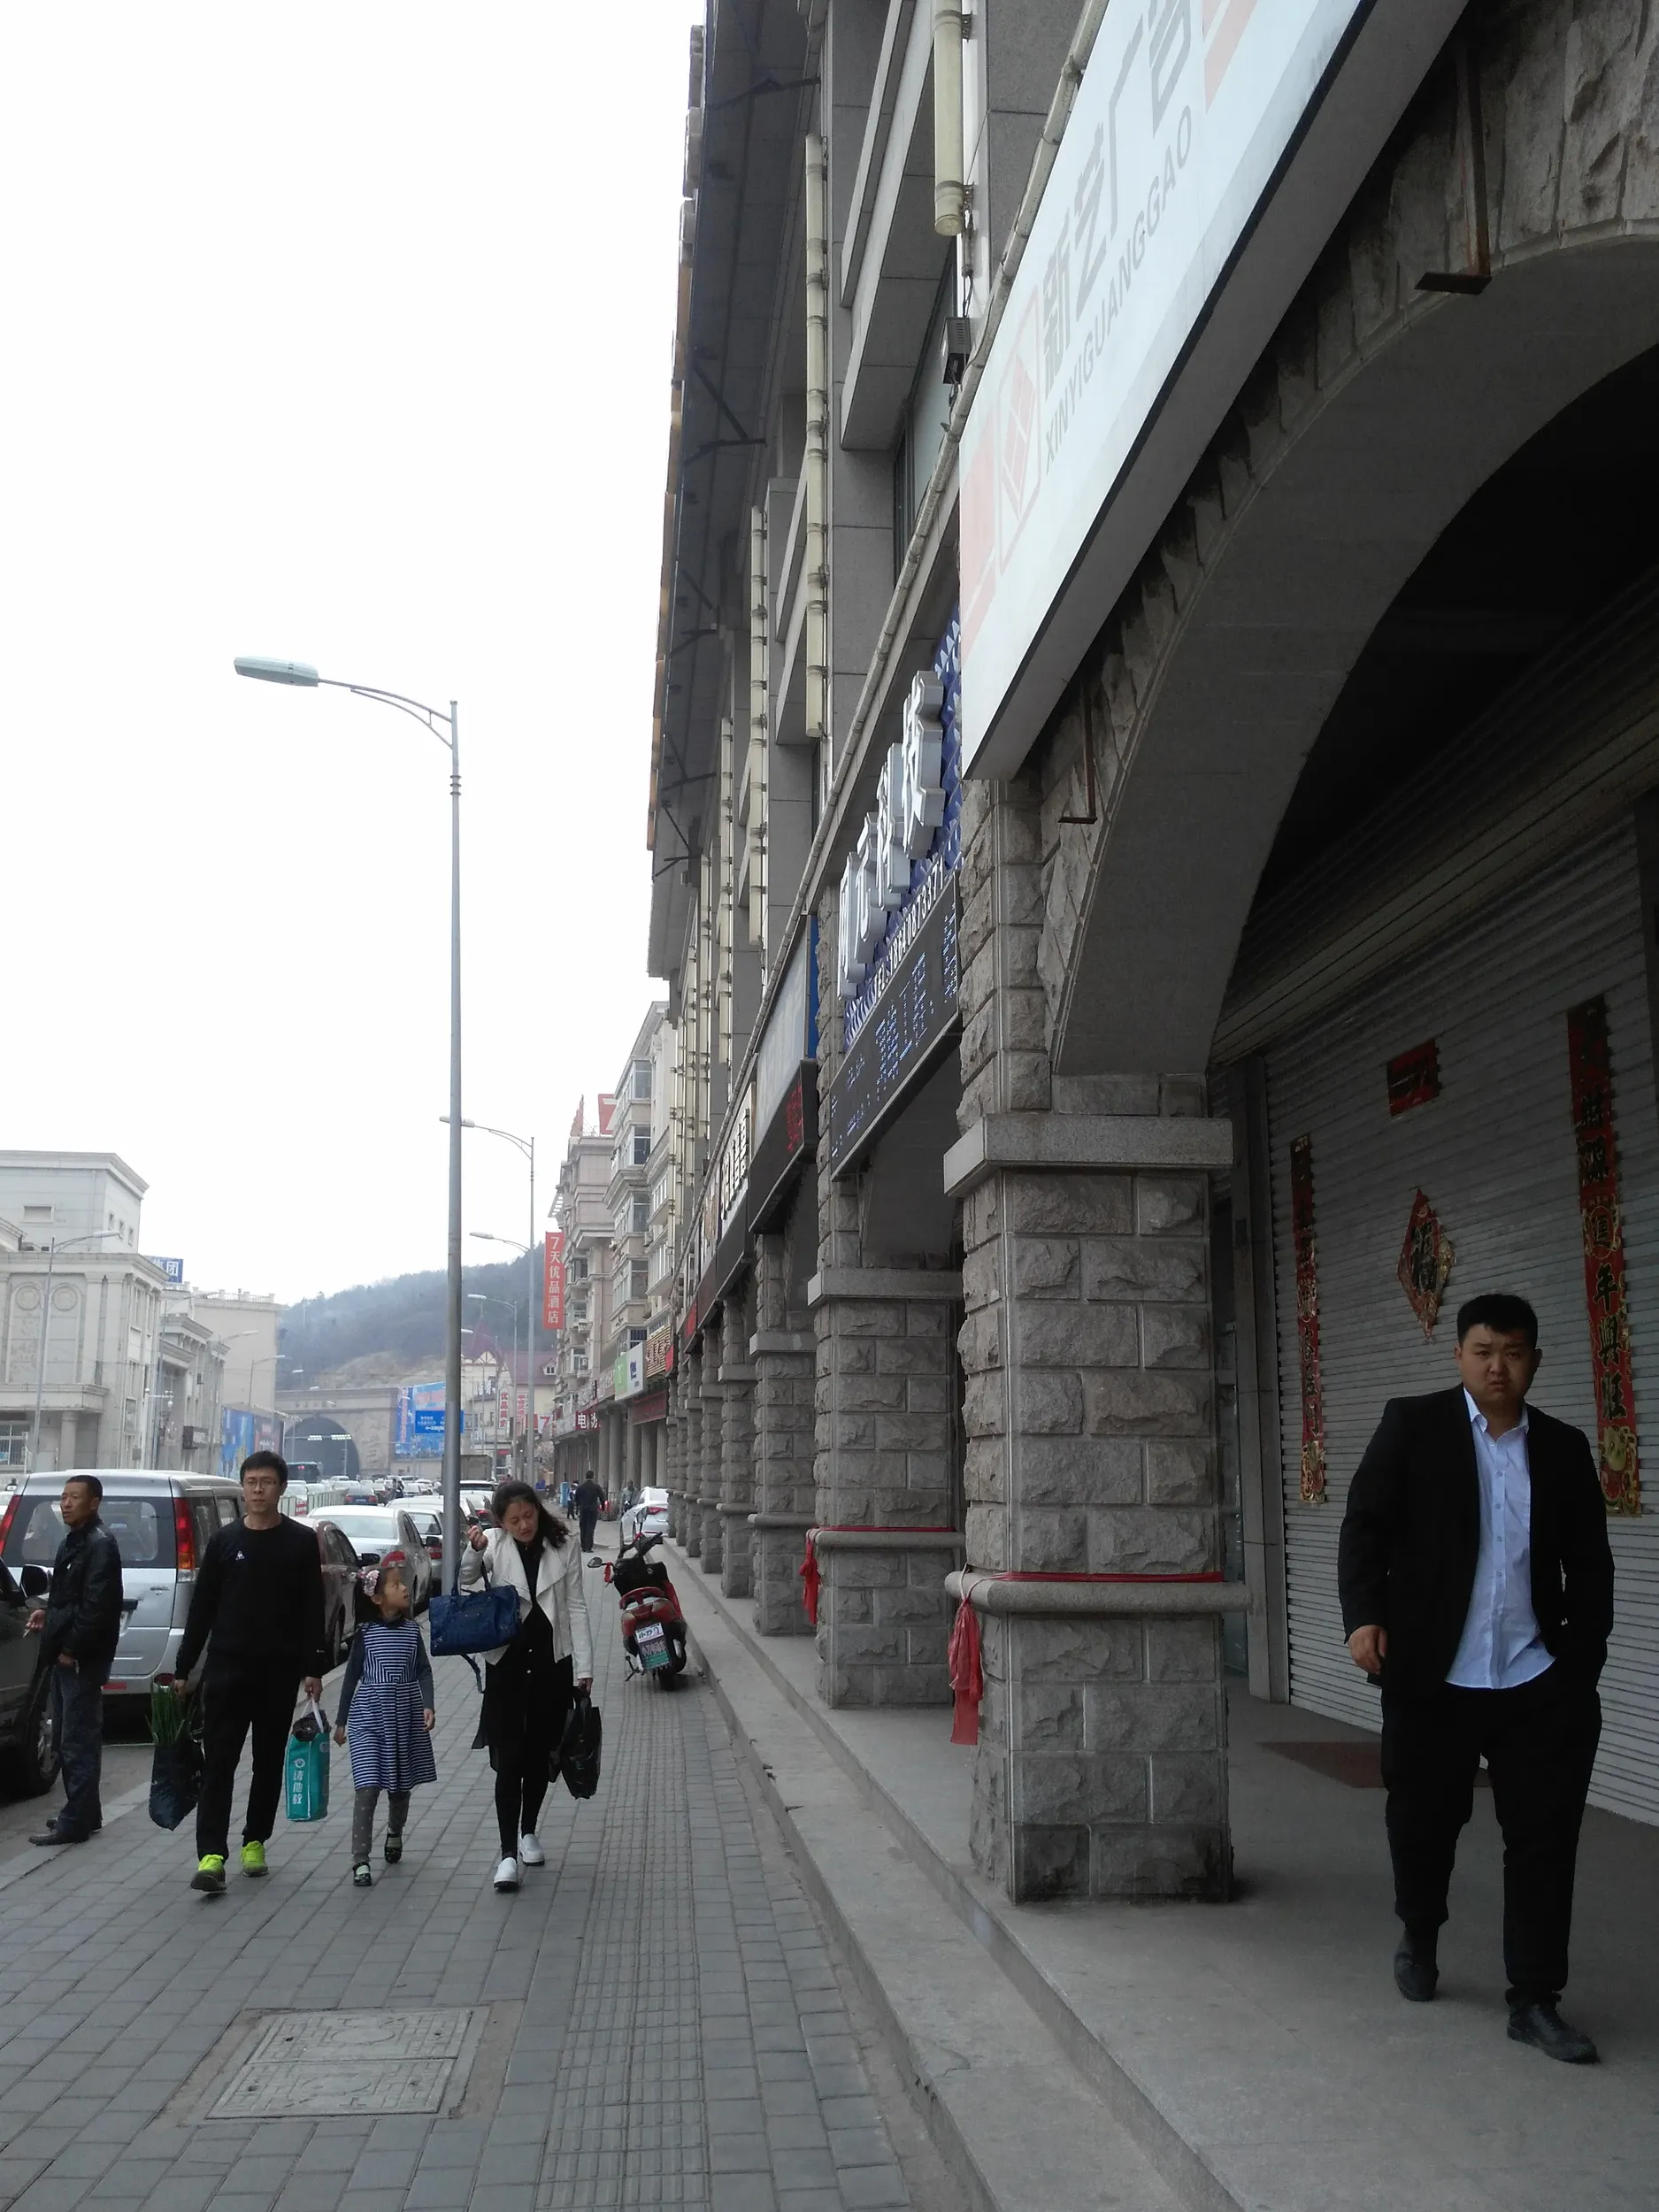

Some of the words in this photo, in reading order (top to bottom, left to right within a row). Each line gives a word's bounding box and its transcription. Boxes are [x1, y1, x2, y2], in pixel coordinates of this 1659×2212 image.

[1044, 105, 1192, 476] XINYIGUANGGAO
[548, 1236, 561, 1324] 7天优品酒店
